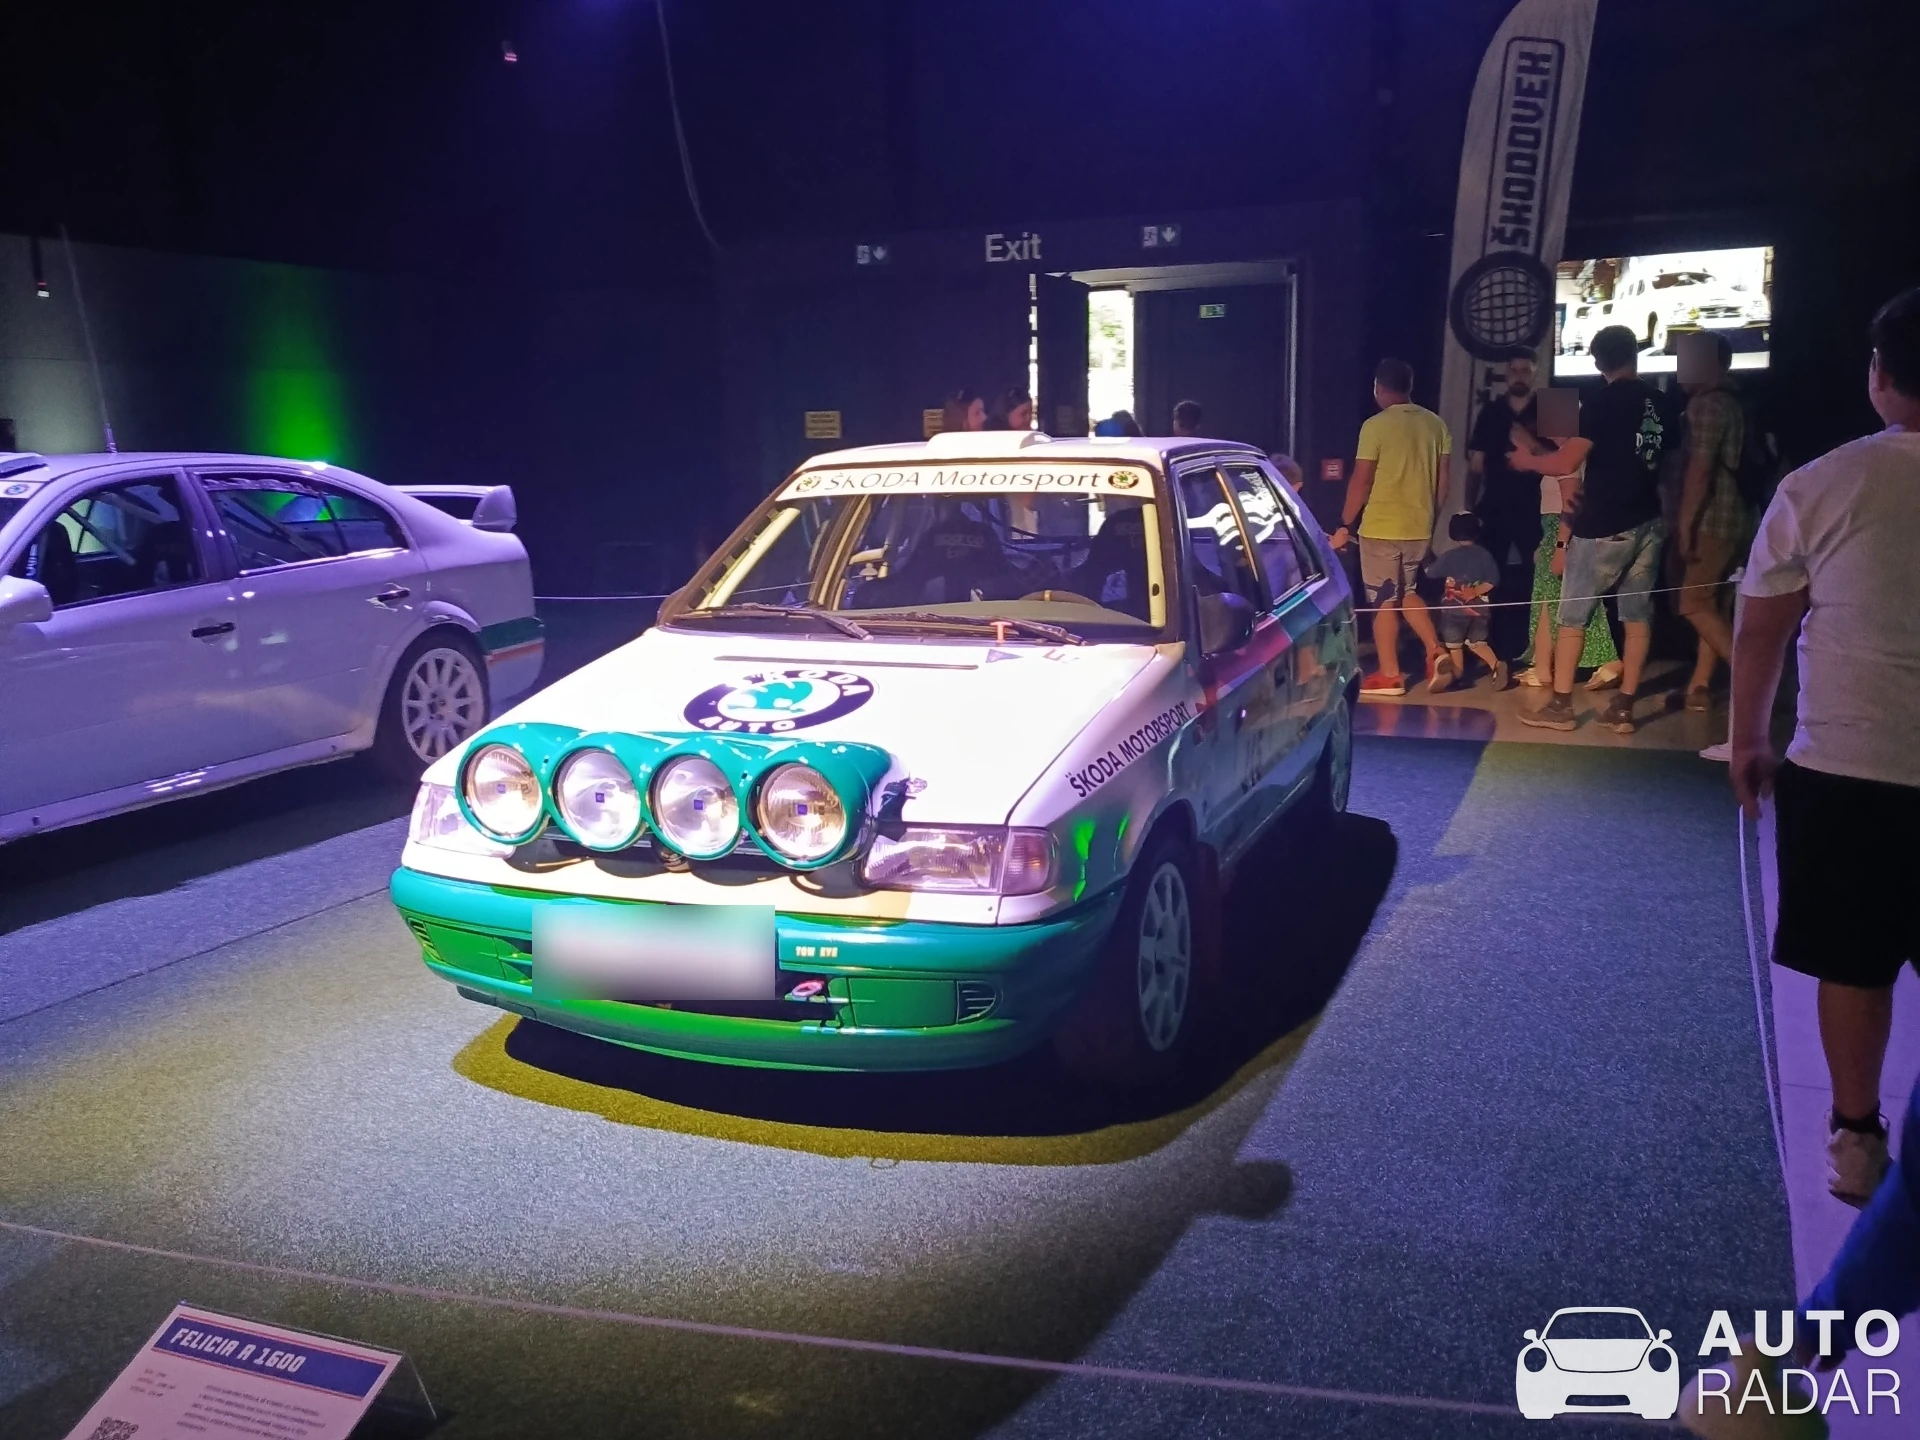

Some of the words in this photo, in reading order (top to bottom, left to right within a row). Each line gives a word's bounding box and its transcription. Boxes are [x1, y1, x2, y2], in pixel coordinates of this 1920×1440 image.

[1491, 51, 1552, 248] ŠKODOVEK
[984, 232, 1042, 262] Exit
[825, 471, 919, 490] ŠKODA
[931, 470, 1101, 491] Motorsport
[698, 715, 796, 733] AUTO
[1065, 750, 1125, 797] ŠKODA
[1118, 701, 1191, 762] MOTORSPORT
[171, 1327, 240, 1357] FELICIA
[238, 1344, 257, 1361] A
[253, 1347, 308, 1373] 1600
